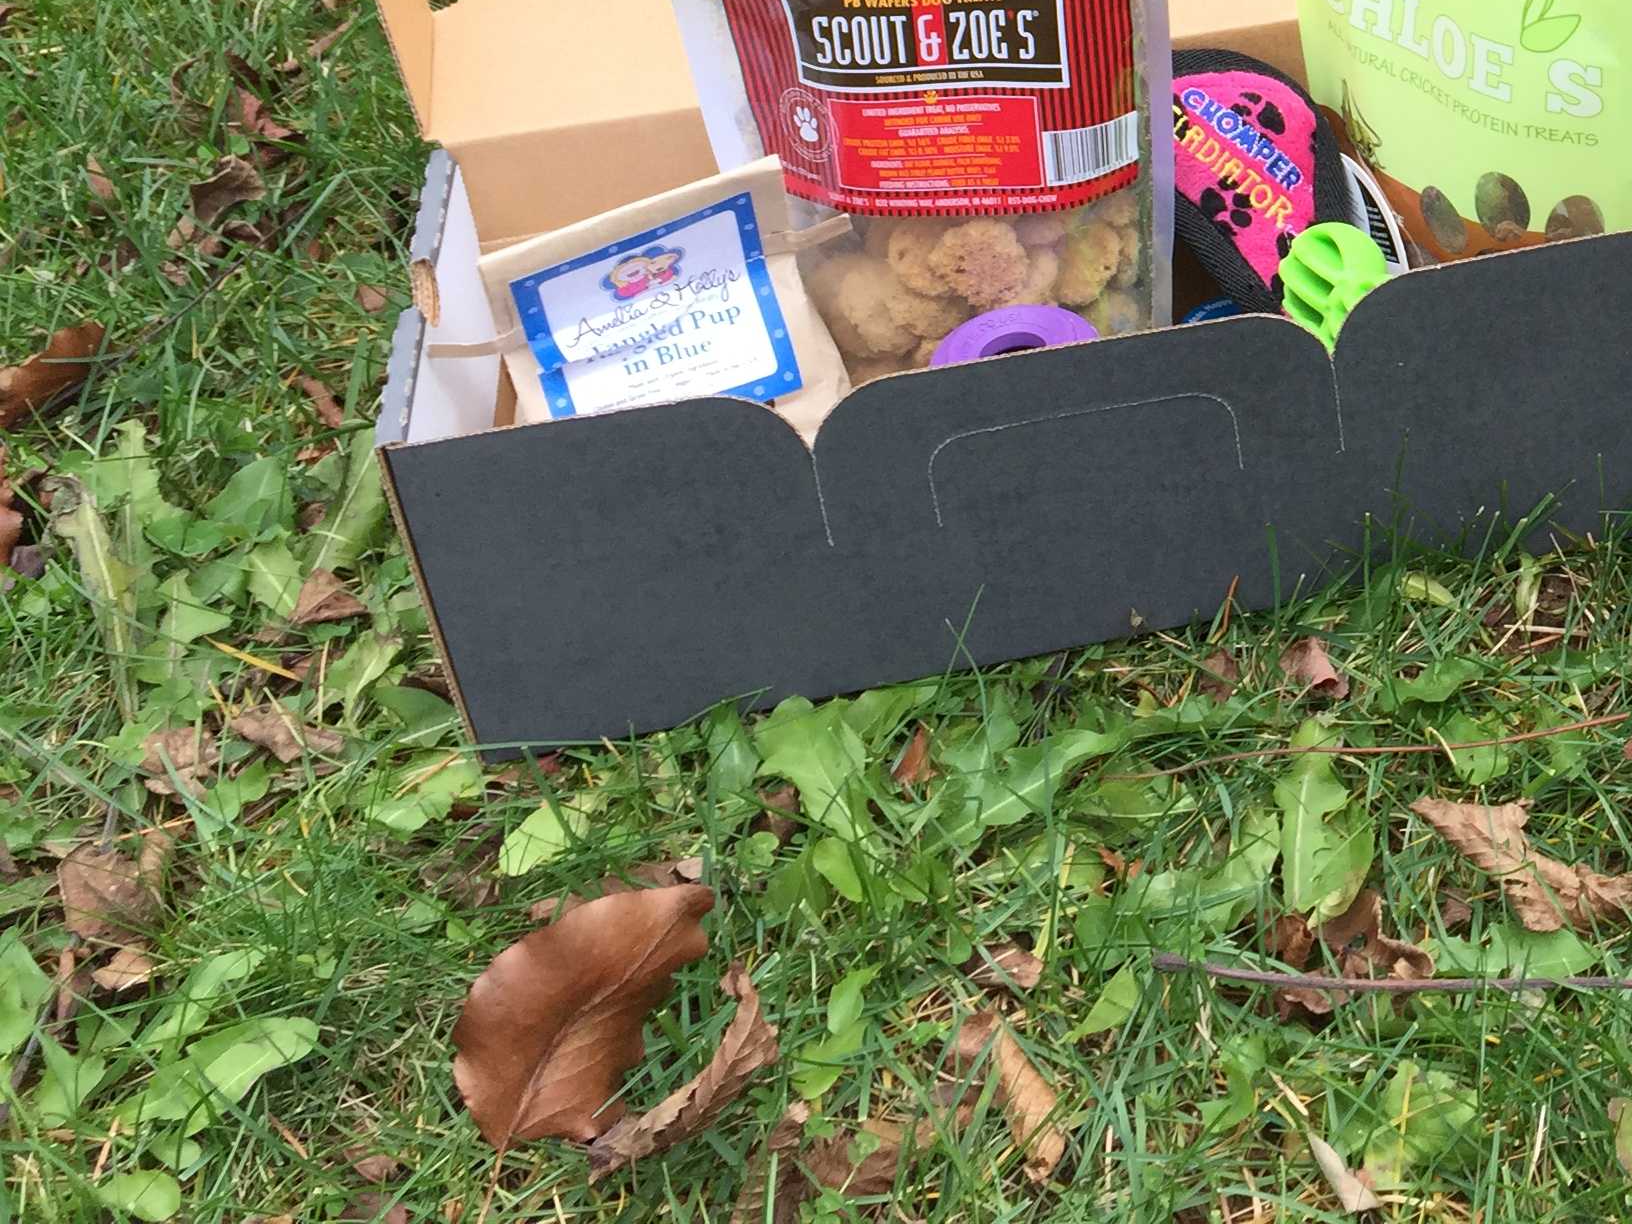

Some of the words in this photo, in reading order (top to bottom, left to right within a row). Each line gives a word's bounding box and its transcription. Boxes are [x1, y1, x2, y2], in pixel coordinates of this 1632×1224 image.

[811, 14, 907, 66] SCOUT
[916, 13, 942, 62] &
[1345, 38, 1397, 78] TURAL
[1452, 99, 1519, 137] PROTEIN
[1524, 124, 1600, 147] TREATS
[1181, 87, 1304, 191] CHOMPER
[1172, 104, 1293, 229] LADIATOR
[567, 304, 649, 348] Amelia
[688, 305, 741, 330] Pup
[622, 357, 650, 376] in
[653, 340, 712, 366] Blue
